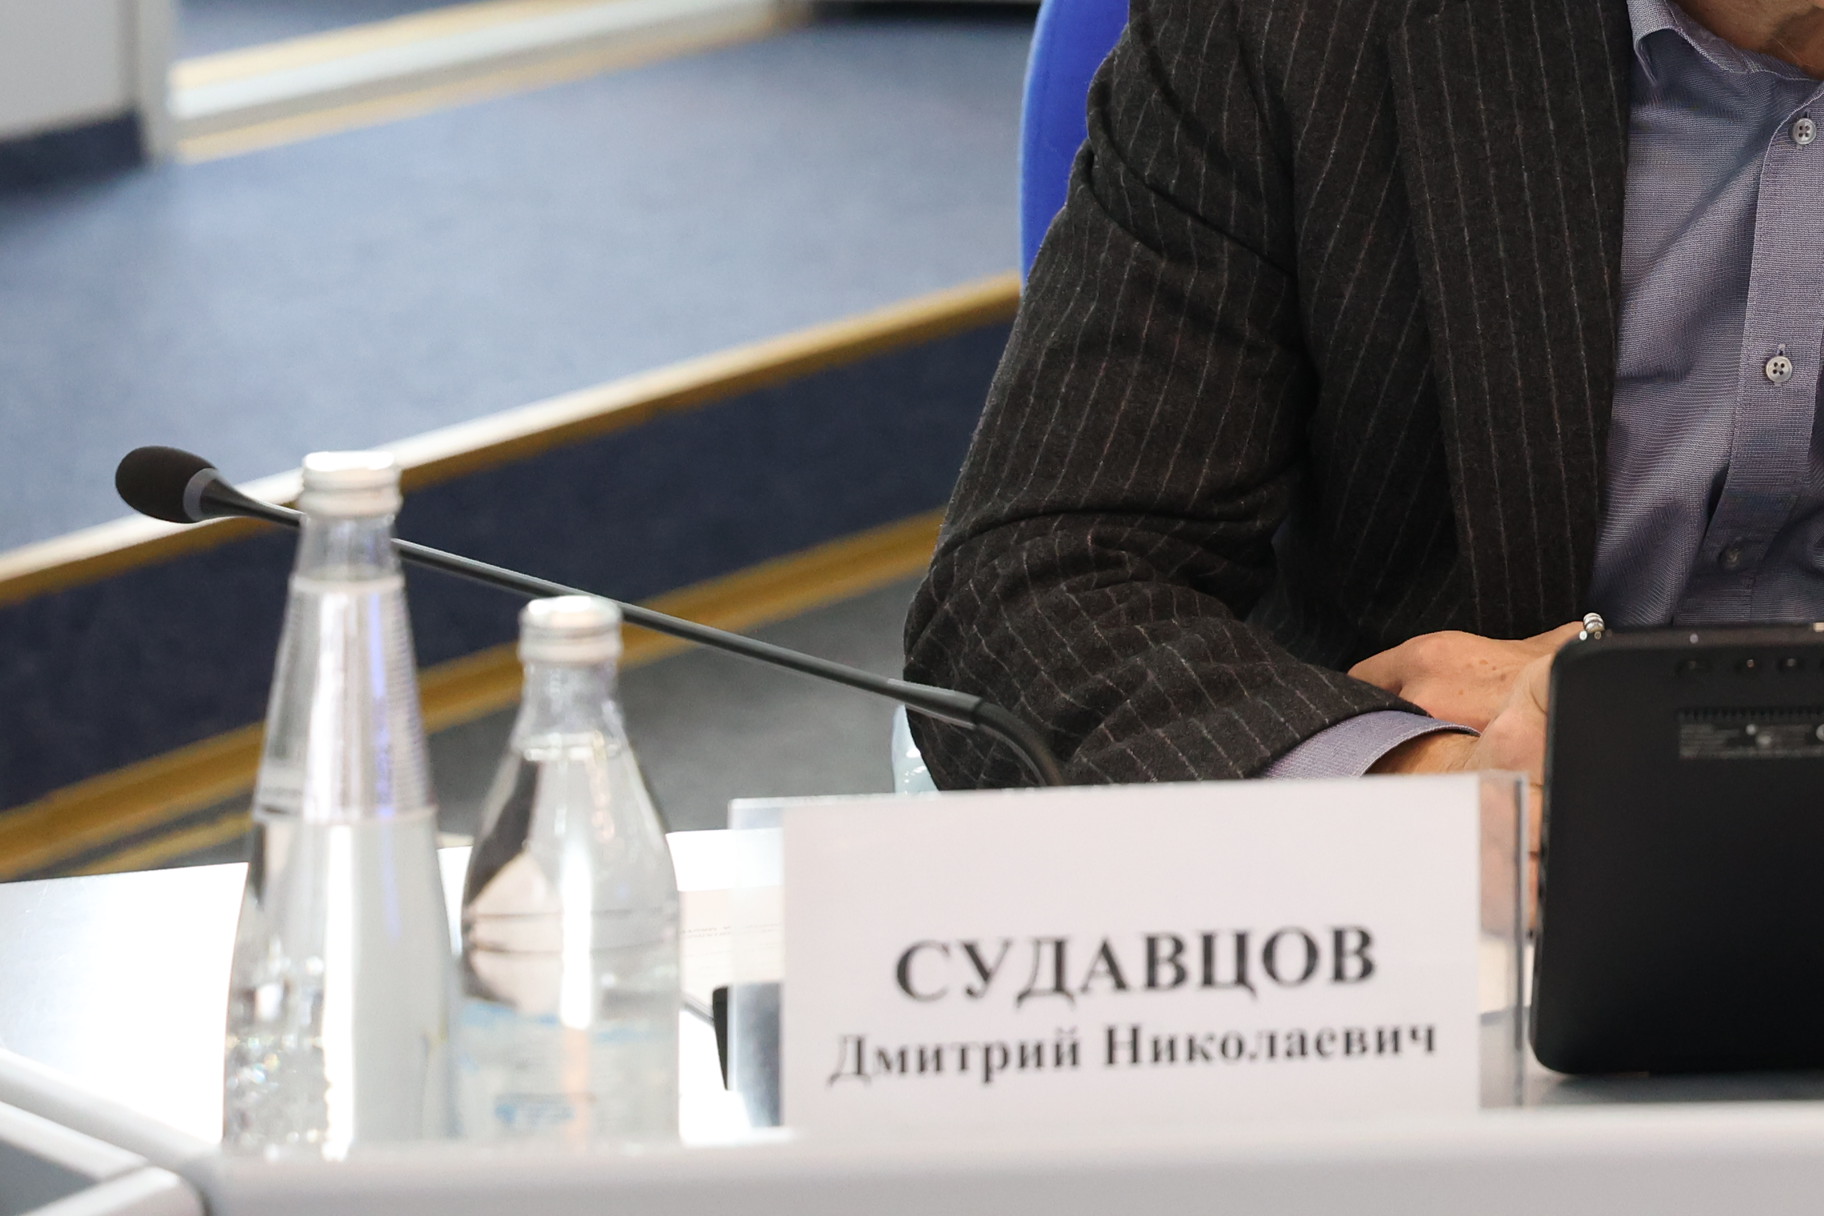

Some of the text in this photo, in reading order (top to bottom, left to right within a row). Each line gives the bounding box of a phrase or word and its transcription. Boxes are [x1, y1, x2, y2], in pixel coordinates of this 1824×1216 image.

[894, 925, 1376, 1009] СУДАВЦОВ
[828, 1021, 1435, 1086] Дмитрий Николаевич
